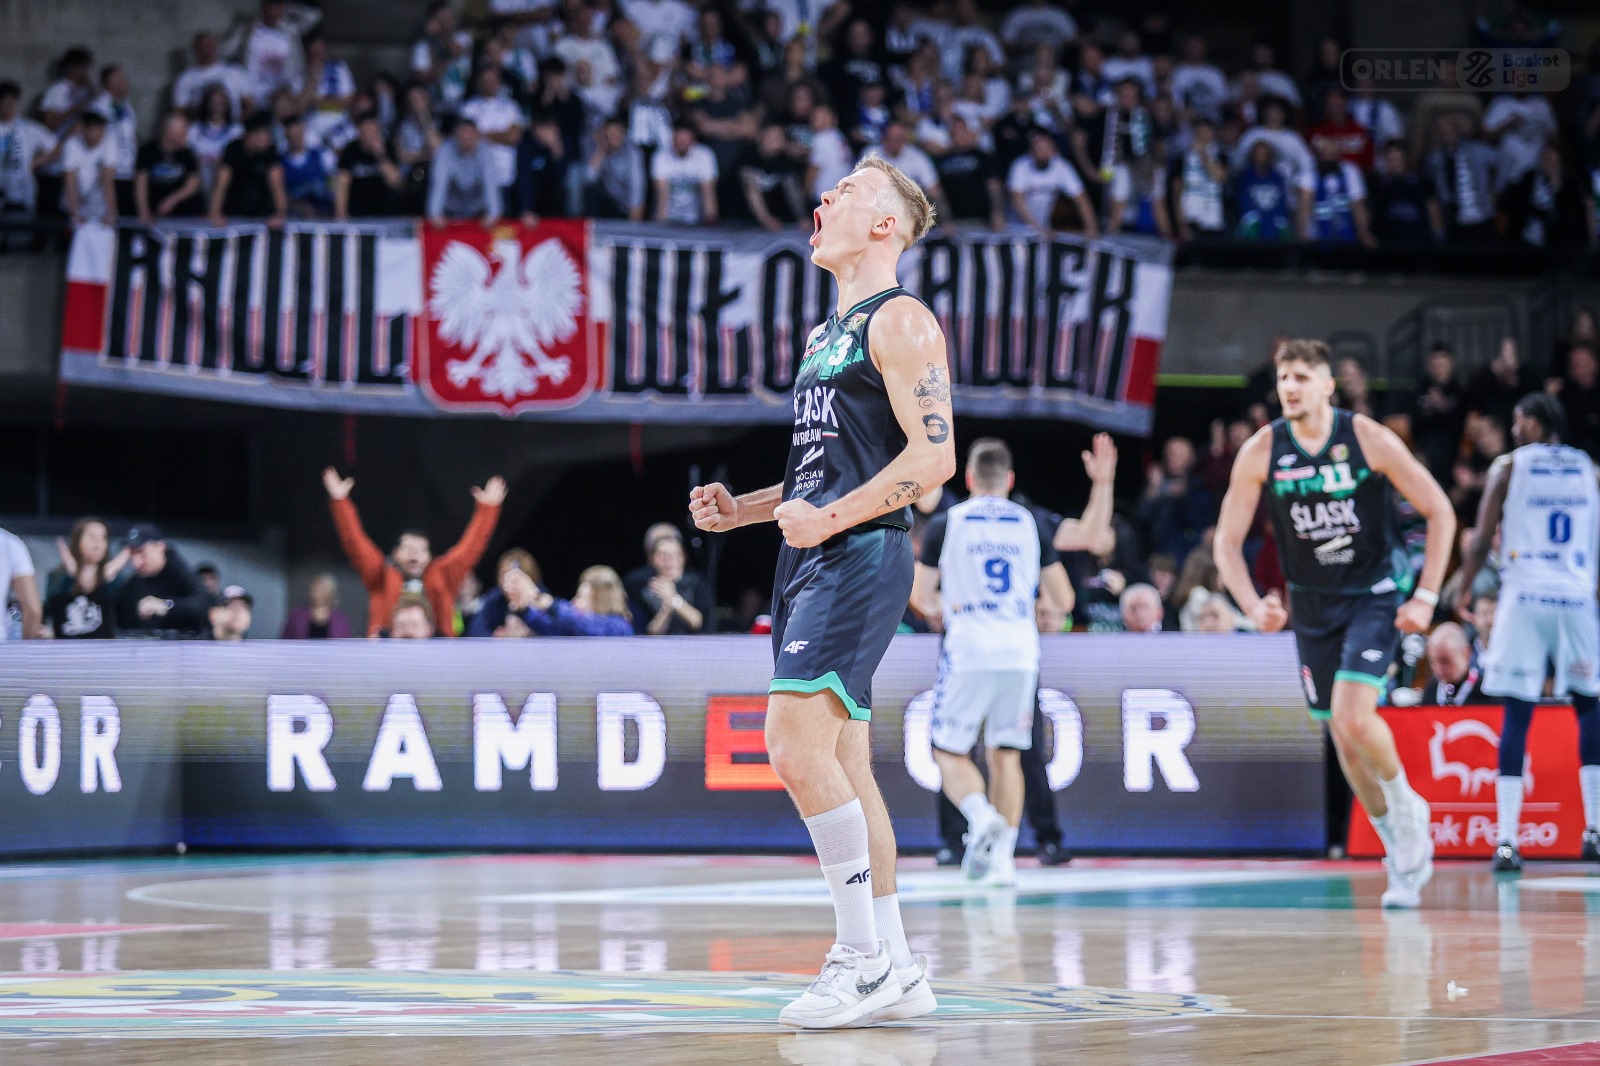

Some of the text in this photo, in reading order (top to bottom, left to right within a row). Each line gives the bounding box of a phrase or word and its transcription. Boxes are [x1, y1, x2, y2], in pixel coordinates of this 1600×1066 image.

[612, 236, 1136, 404] WŁOAWEK
[828, 334, 853, 366] 3
[1319, 462, 1356, 494] 11
[1549, 511, 1571, 543] 0
[985, 558, 1011, 593] 9
[784, 640, 809, 653] 4F
[0, 693, 122, 796] OR
[1465, 815, 1559, 847] Peao
